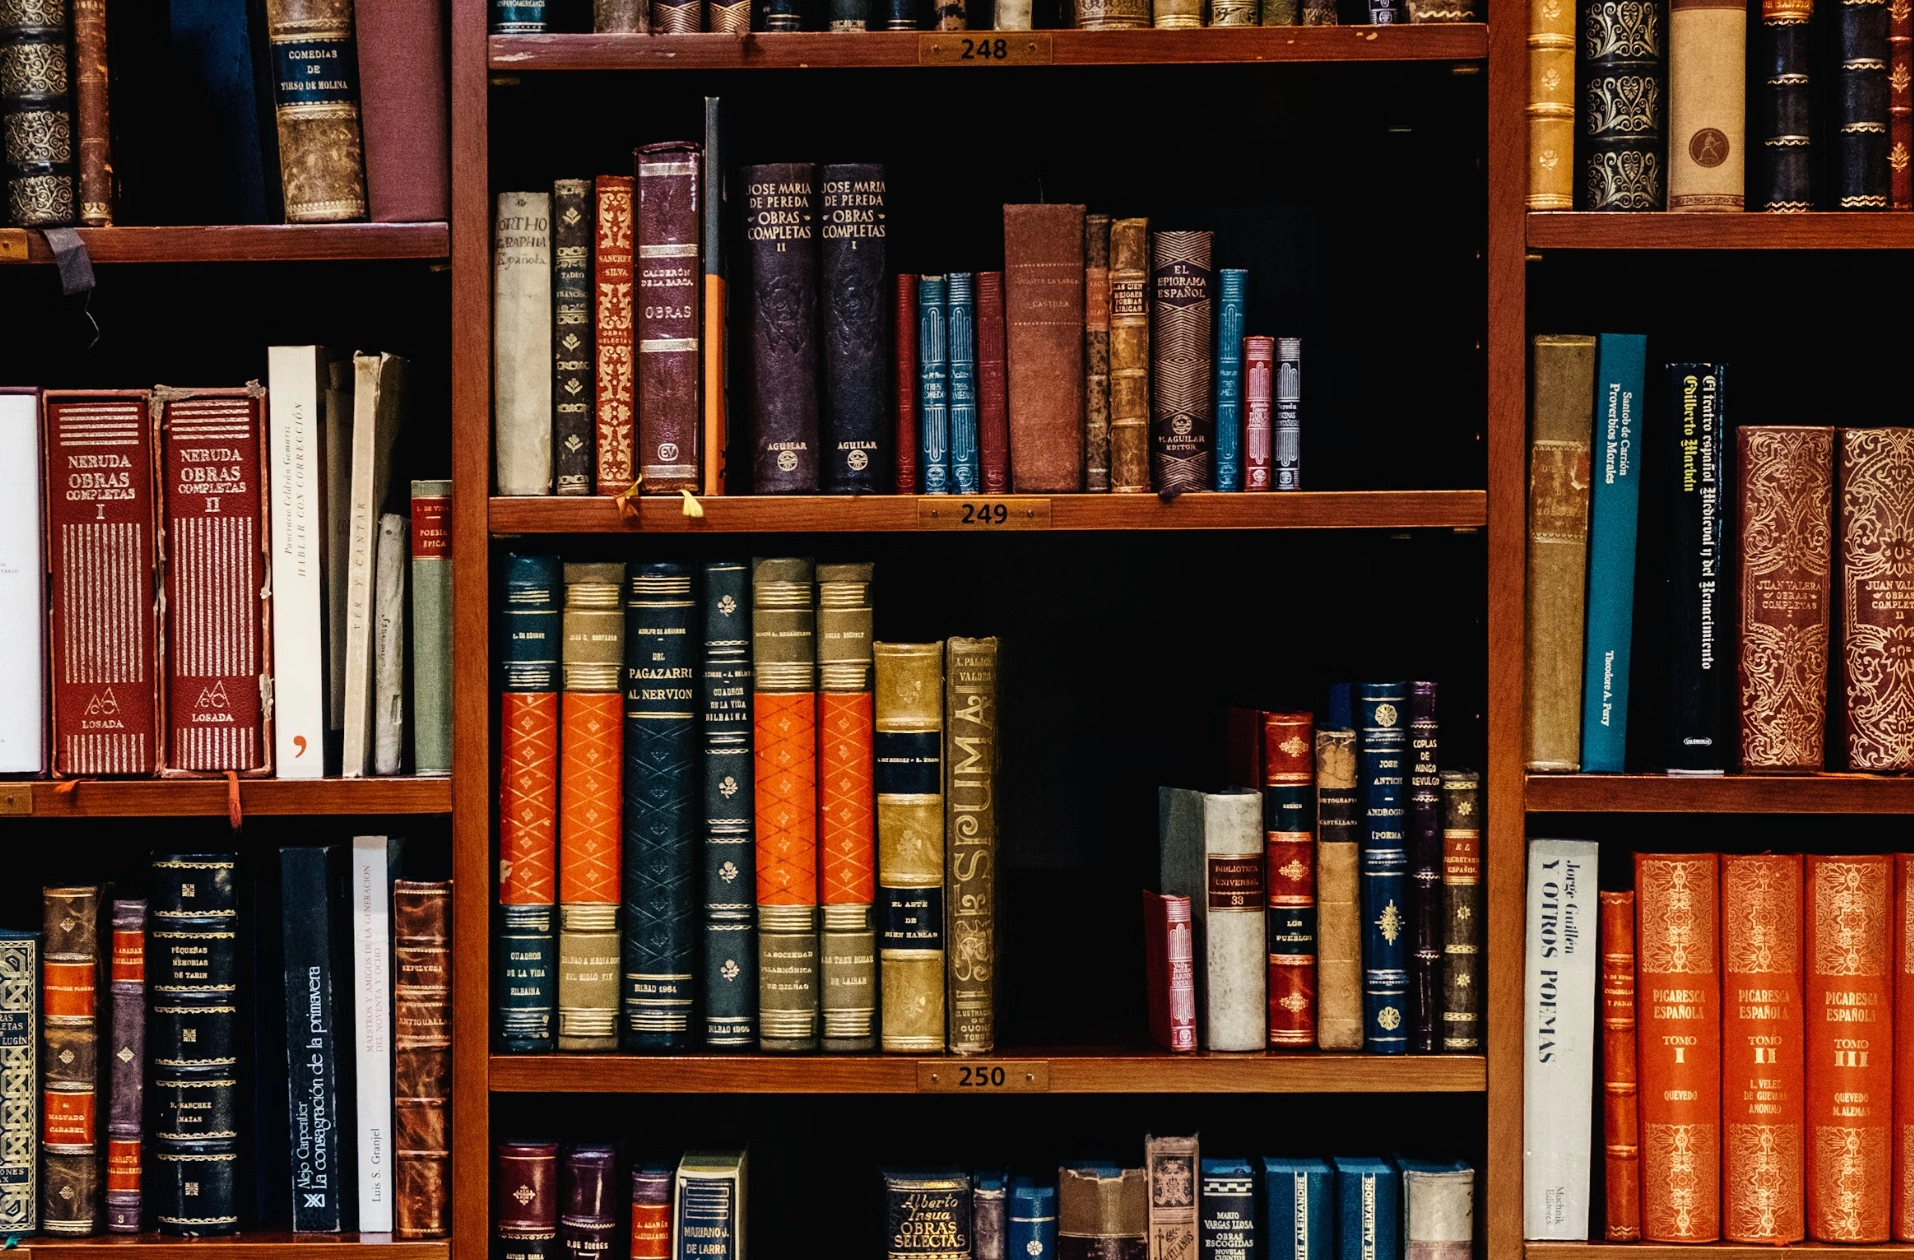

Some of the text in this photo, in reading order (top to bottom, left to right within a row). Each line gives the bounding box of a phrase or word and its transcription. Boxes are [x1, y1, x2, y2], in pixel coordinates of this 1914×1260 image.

[962, 39, 1007, 59] 248
[307, 65, 320, 74] DE
[746, 182, 812, 195] JOSE MARIA
[821, 181, 886, 194] JOSE MARIA
[750, 196, 809, 209] DE PEREDA
[824, 195, 884, 207] DE PEREDA
[758, 211, 800, 225] OBRAS
[832, 209, 875, 223] OBRAS
[747, 226, 812, 240] COMPLETAS
[822, 225, 886, 239] COMPLETAS
[1174, 265, 1189, 275] EL
[1157, 277, 1207, 287] EPIGRAMA
[1157, 286, 1206, 299] ESPAÑOL
[645, 305, 692, 319] OBRAS
[1606, 383, 1621, 484] Proverbios Morales
[1619, 392, 1633, 476] Santob de Carrión
[767, 441, 808, 450] AGUILAR
[837, 441, 878, 450] AGUILAR
[68, 455, 131, 469] NERUDA
[180, 449, 243, 463] NERUDA
[69, 472, 130, 488] OBRAS
[181, 466, 241, 482] OBRAS
[66, 488, 136, 500] COMPLETAS
[178, 482, 247, 494] COMPLETAS
[96, 504, 105, 520] I
[205, 497, 221, 513] II
[962, 504, 1007, 524] 249
[355, 502, 367, 567] CANTAR
[1756, 580, 1784, 591] JUAN
[1776, 592, 1808, 600] OBRAS
[1762, 601, 1817, 610] COMPLETAS
[354, 601, 363, 630] VER
[629, 668, 693, 679] PAGAZARRI
[1604, 650, 1615, 690] Theodore
[628, 689, 693, 700] AL NERVION
[192, 713, 234, 722] LOSADA
[1601, 702, 1612, 726] Perry
[82, 719, 124, 729] LOSADA
[1413, 739, 1438, 749] COPLAS
[1420, 751, 1431, 761] DE
[1231, 895, 1244, 906] 33
[1563, 903, 1580, 954] Guillén
[1539, 859, 1560, 1064] Y OTROS POEMAS
[1653, 989, 1706, 1003] PICARESCA
[1738, 989, 1790, 1003] PICARESCA
[1825, 991, 1878, 1006] PICARESCA
[1654, 1005, 1704, 1019] ESPAÑOLA
[1739, 1005, 1788, 1019] ESPAÑOLA
[1826, 1008, 1876, 1023] ESPAÑOLA
[1662, 1036, 1697, 1046] TOMO
[1748, 1036, 1782, 1046] TOMO
[1834, 1039, 1869, 1049] TOMO
[1675, 1047, 1685, 1064] I
[1754, 1047, 1777, 1064] II
[1834, 1050, 1869, 1067] III
[306, 965, 332, 1190] La consagración de la primavera
[959, 1067, 1005, 1087] 250
[1759, 1079, 1782, 1089] VELEZ
[1664, 1090, 1698, 1101] QUEVEDO
[1834, 1092, 1869, 1104] QUEVEDO
[297, 1101, 314, 1189] Alejo Carpentier
[371, 1128, 383, 1203] Luis S. Granjel
[900, 1193, 959, 1209] Alberto
[907, 1207, 952, 1221] Insua
[1217, 1212, 1240, 1220] MARIO
[684, 1226, 721, 1238] MARIANO
[900, 1221, 957, 1235] OBRAS
[1204, 1220, 1230, 1230] VARGAS
[894, 1234, 966, 1248] SELECTAS
[1205, 1239, 1254, 1248] ESCOGIDAS
[686, 1243, 727, 1255] DE LARRA
